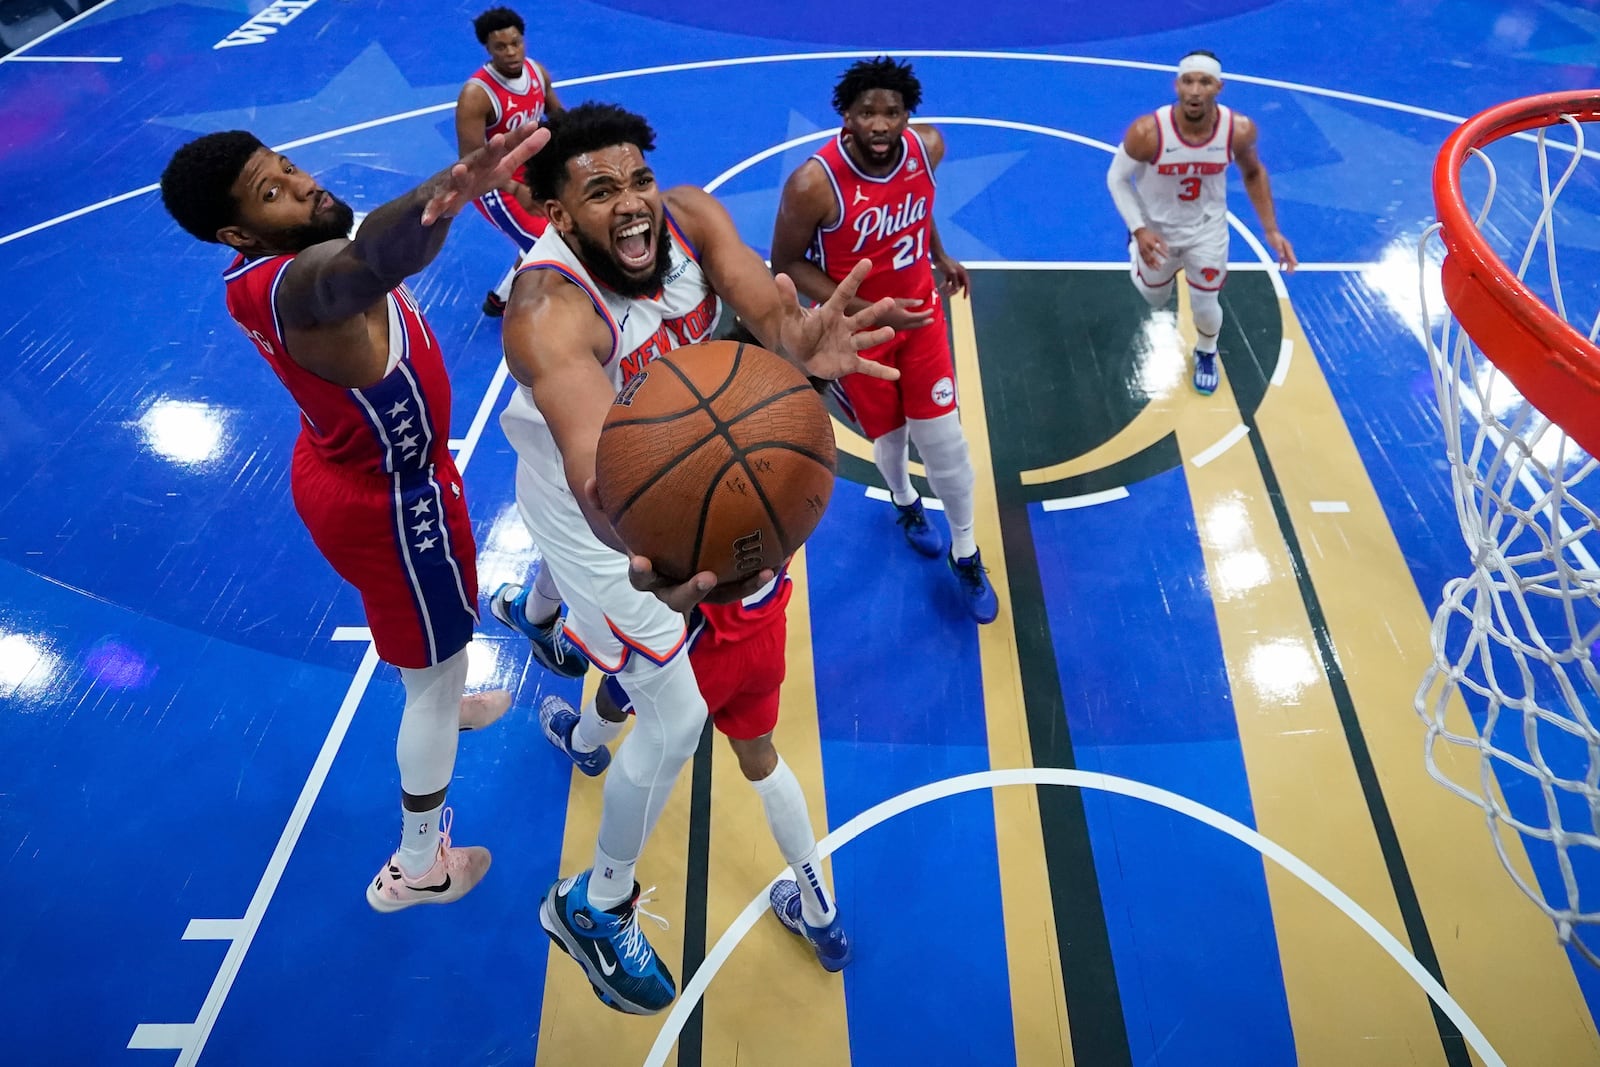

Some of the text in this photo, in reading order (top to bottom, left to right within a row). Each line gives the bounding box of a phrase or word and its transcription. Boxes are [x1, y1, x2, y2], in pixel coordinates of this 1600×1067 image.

[1178, 176, 1202, 201] 3
[852, 193, 926, 252] Phila
[892, 227, 925, 271] 21
[620, 321, 673, 387] NEW
